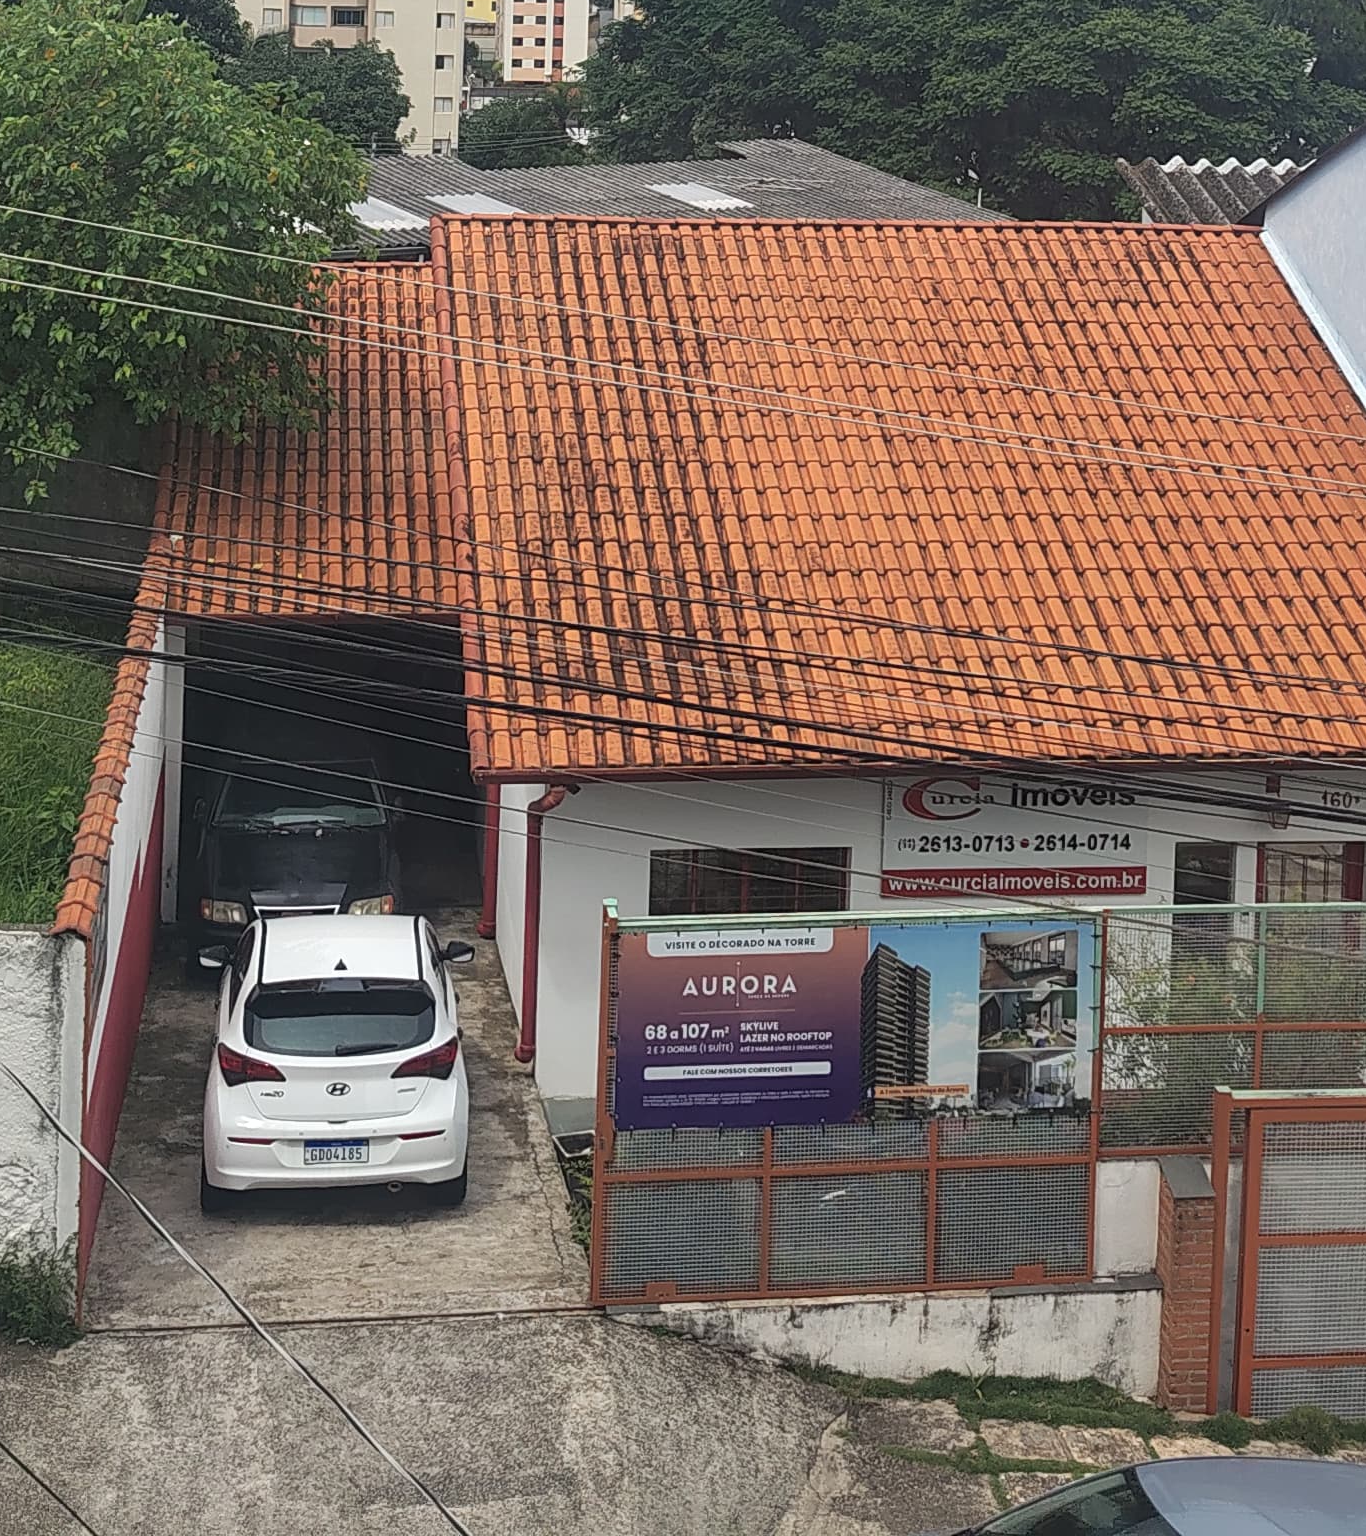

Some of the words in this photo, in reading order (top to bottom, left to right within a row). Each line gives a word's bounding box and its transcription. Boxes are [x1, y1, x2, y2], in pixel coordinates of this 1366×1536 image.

[918, 834, 1016, 853] 2613-0713
[1033, 833, 1132, 852] 2614-0714
[888, 871, 1144, 892] www.curciaimoveis.com.br
[665, 941, 696, 950] VISITE
[698, 940, 707, 949] O
[708, 939, 765, 949] DECORADO
[767, 938, 782, 947] NA
[785, 937, 816, 947] TORRE
[682, 974, 797, 997] AURORA
[644, 1024, 668, 1041] 68
[669, 1028, 679, 1040] a
[681, 1023, 710, 1039] 107
[711, 1025, 730, 1038] m²
[740, 1021, 779, 1032] SKYLIVE
[740, 1033, 769, 1043] LAZER
[770, 1032, 785, 1042] NO
[786, 1031, 833, 1041] ROOFTOP
[646, 1045, 652, 1055] 2
[666, 1044, 698, 1054] DORMS
